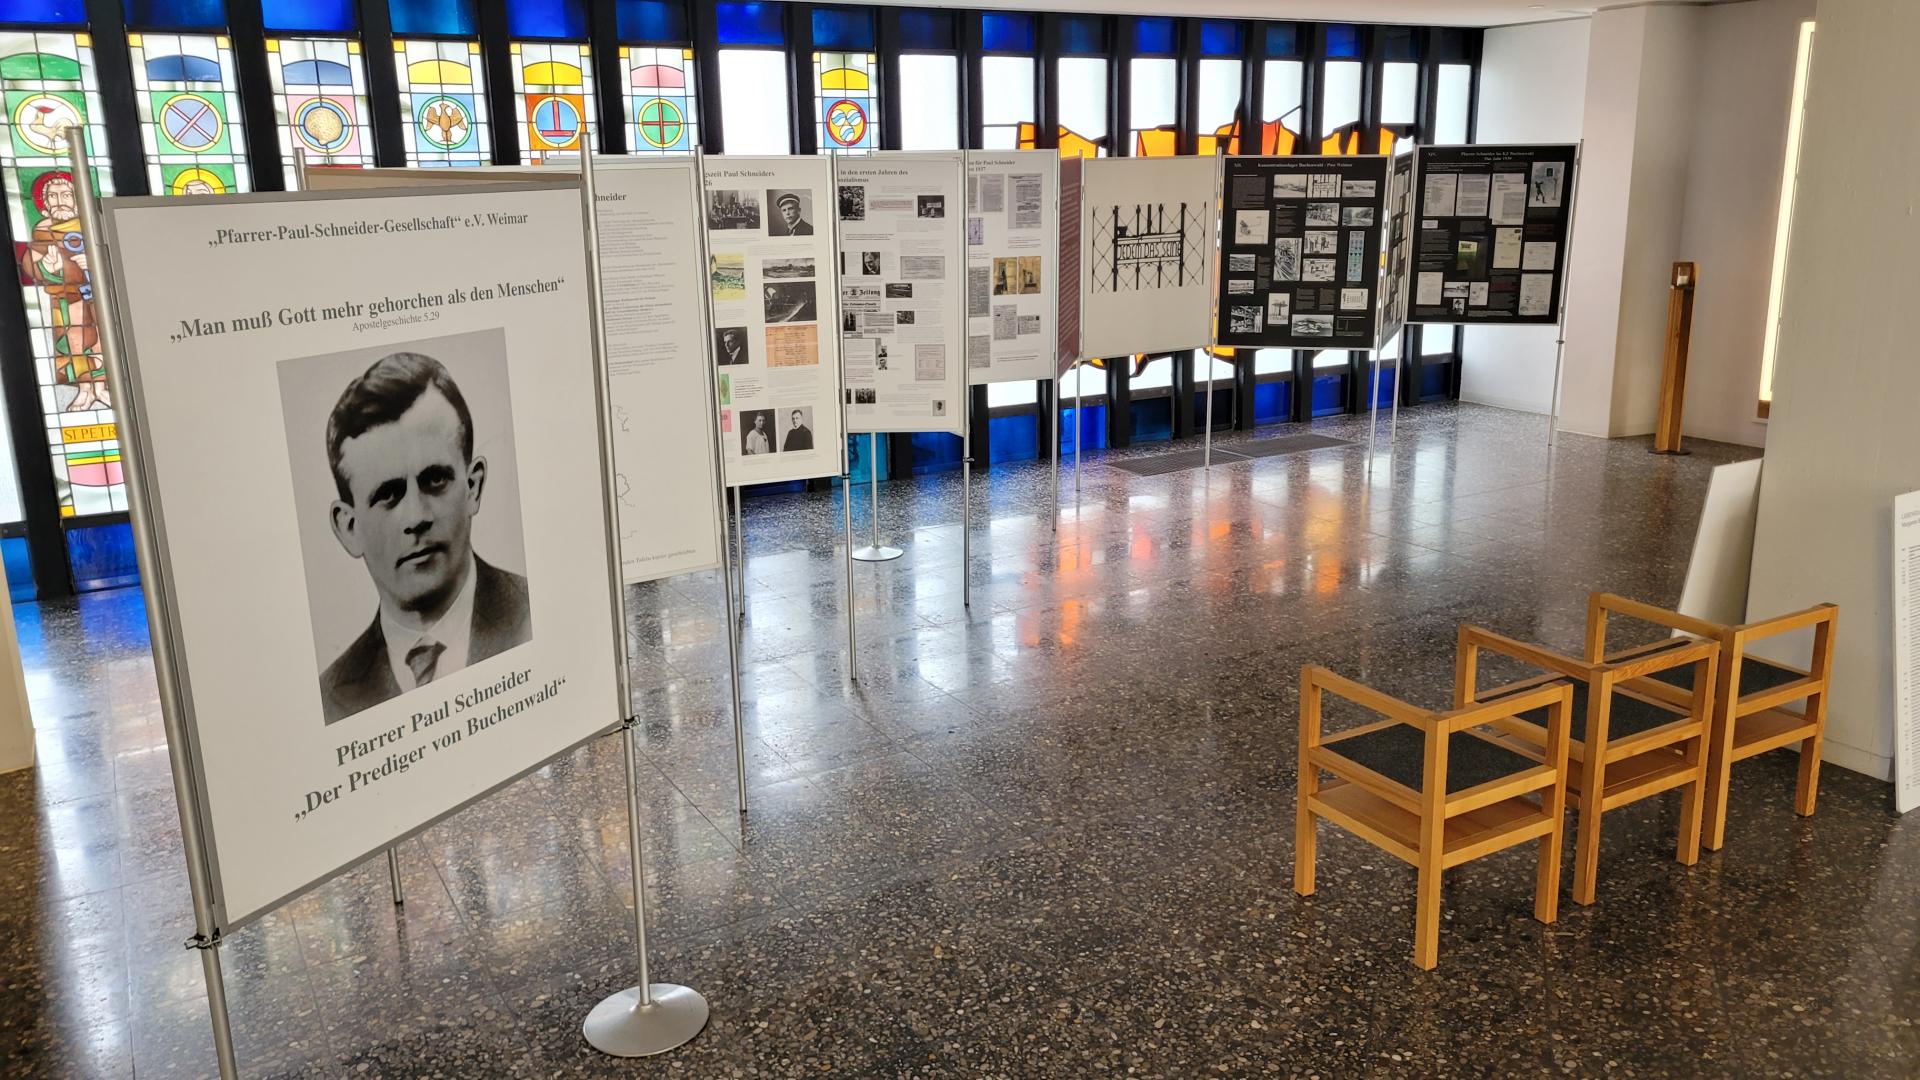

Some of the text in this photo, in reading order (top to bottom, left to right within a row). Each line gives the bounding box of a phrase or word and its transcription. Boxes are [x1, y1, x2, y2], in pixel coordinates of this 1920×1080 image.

[740, 169, 776, 177] Schneiders
[464, 213, 486, 228] e.V.
[487, 211, 529, 226] Weimar
[170, 318, 227, 344] „Man
[232, 310, 273, 332] muß
[278, 306, 317, 326] Gott
[321, 302, 364, 322] mehr
[368, 293, 443, 319] gehorchen
[447, 288, 467, 305] als
[470, 286, 494, 302] den
[352, 313, 422, 333] Apostelgeschichte
[81, 426, 118, 440] PETR
[335, 668, 532, 767] Pfarrer Paul Schneider
[294, 784, 343, 823] „Der
[348, 745, 427, 793] Prediger
[432, 729, 462, 752] von
